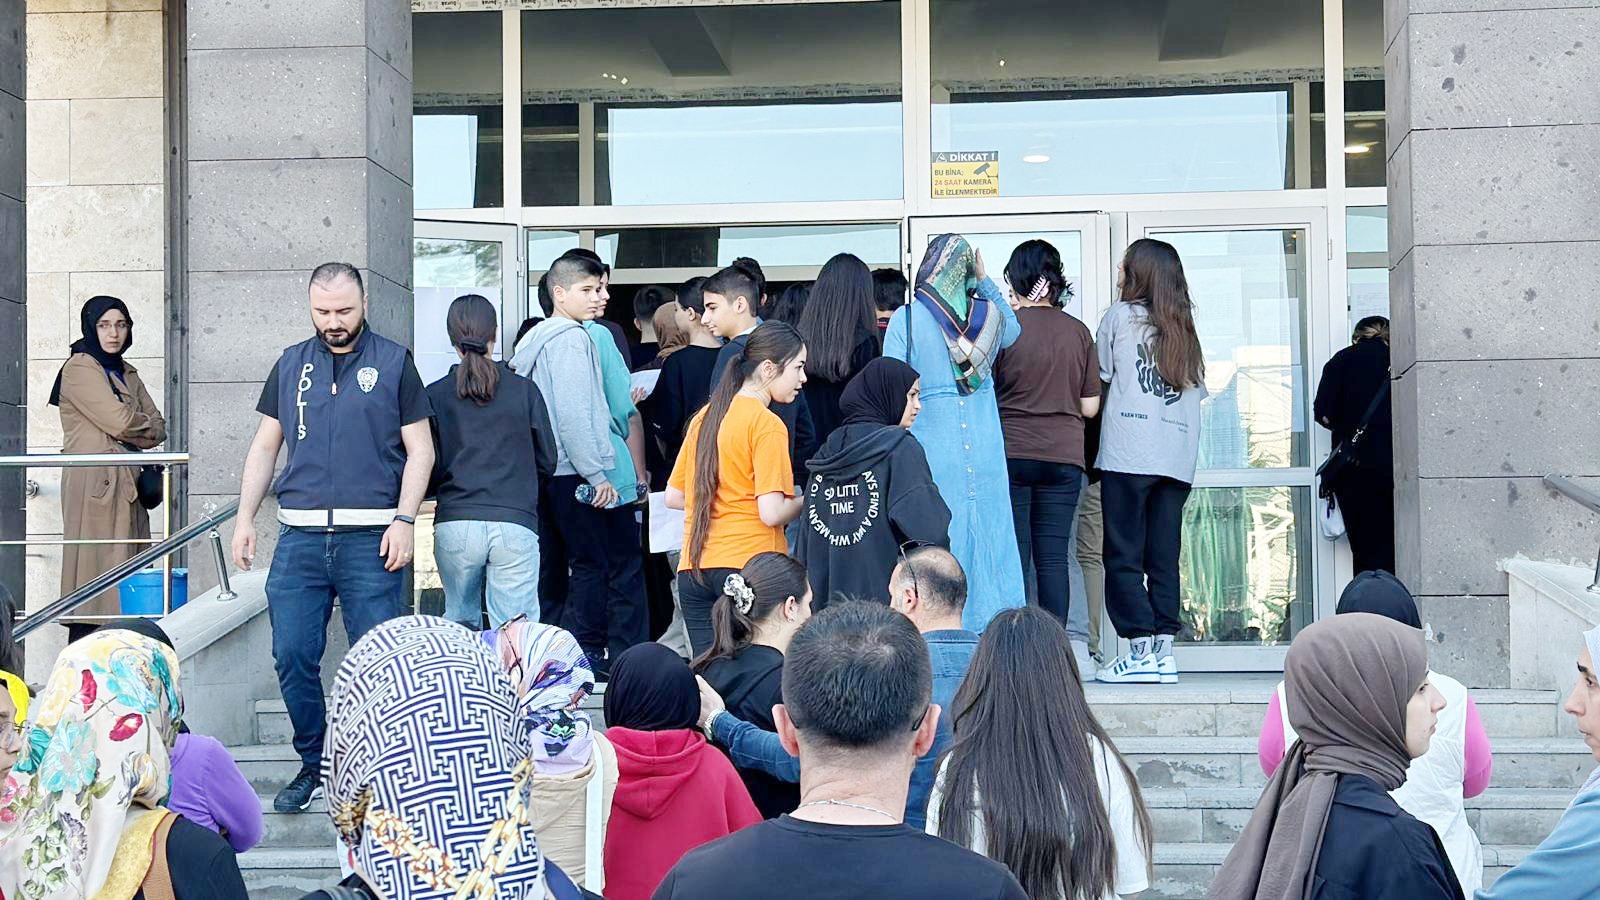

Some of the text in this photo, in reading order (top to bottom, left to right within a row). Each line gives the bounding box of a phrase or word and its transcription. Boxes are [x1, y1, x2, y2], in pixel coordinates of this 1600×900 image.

[950, 152, 988, 162] DİKKAT
[963, 178, 992, 186] KAMERA
[934, 187, 998, 196] İLE İZLENMEKTEDİR
[861, 470, 878, 491] AYS
[824, 487, 835, 501] SO
[830, 501, 854, 515] TIME
[867, 492, 880, 519] FIND
[861, 516, 872, 527] A
[829, 534, 851, 547] WH
